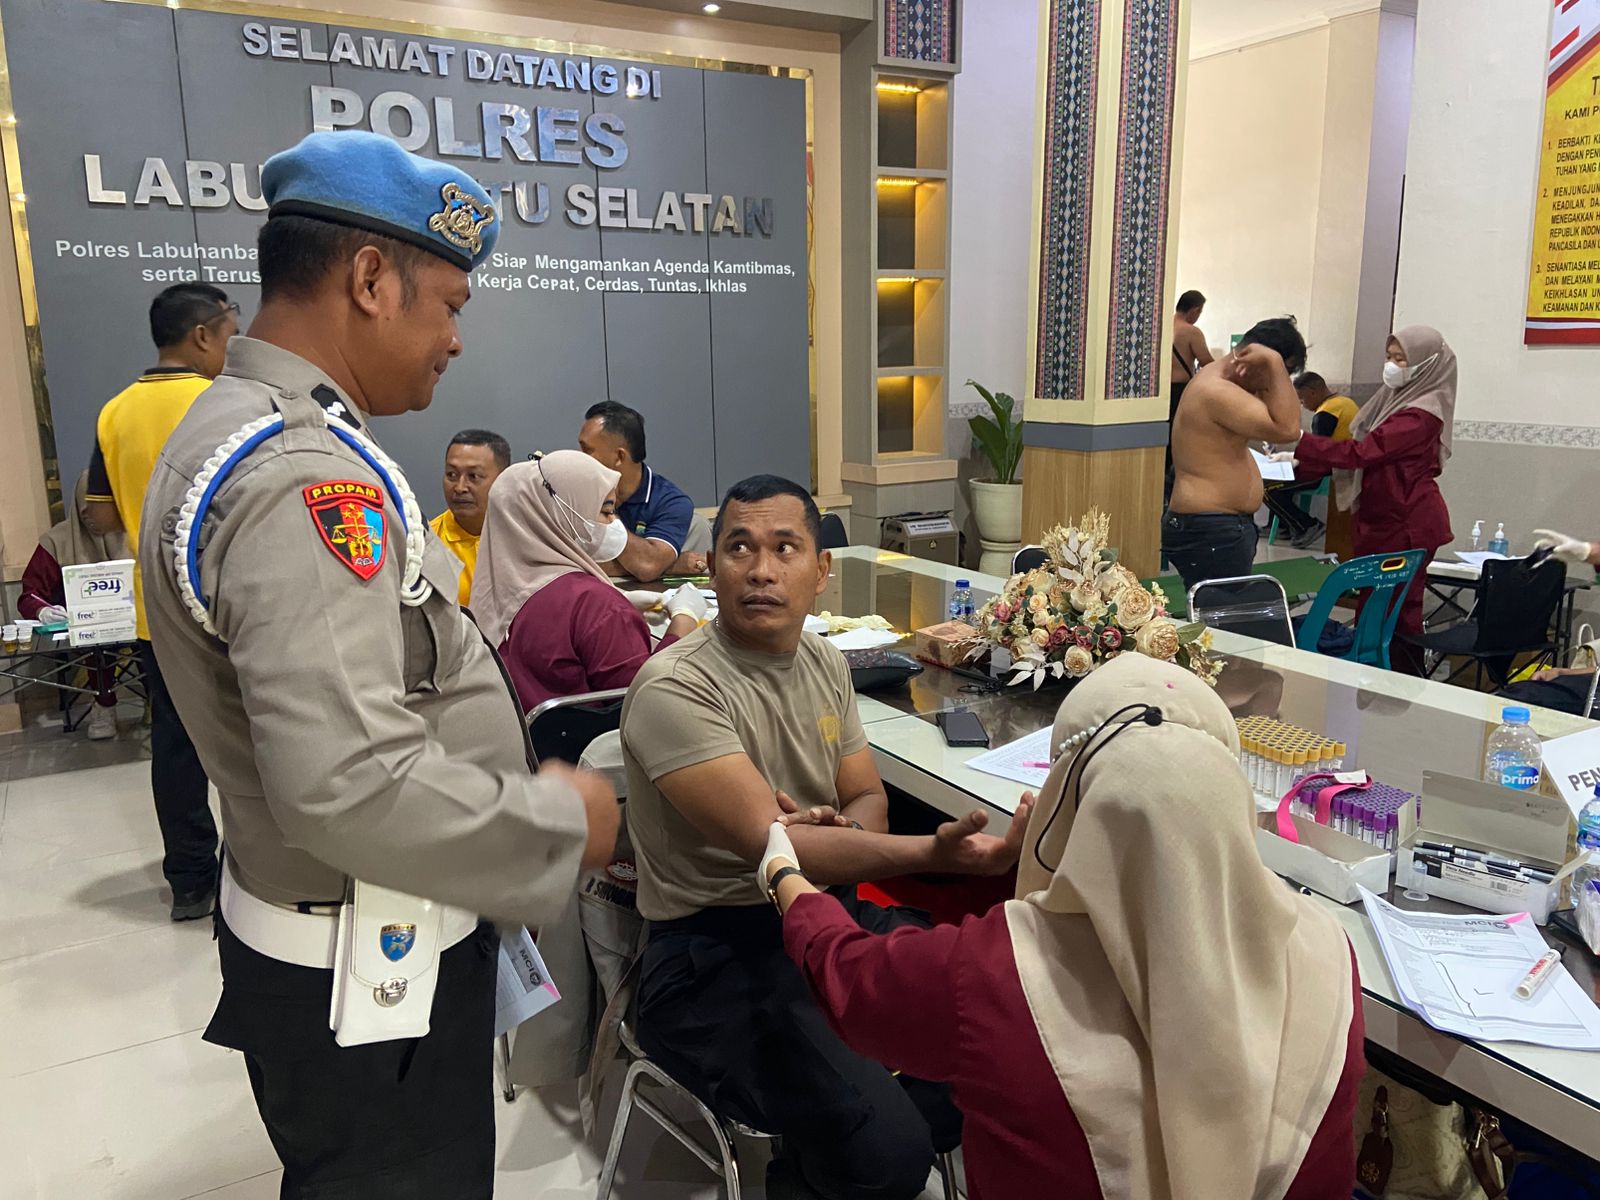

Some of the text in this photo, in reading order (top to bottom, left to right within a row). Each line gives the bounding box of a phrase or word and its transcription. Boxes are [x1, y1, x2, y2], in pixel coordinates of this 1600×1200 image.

[243, 22, 662, 98] SELAMAT DATANG DI
[1564, 106, 1590, 120] KAMI
[311, 85, 629, 168] POLRES
[1557, 135, 1591, 149] BERBAKTI
[1556, 151, 1584, 163] DENGAN
[1555, 162, 1597, 177] TUHAN YANG
[567, 183, 774, 237] SELATAN
[1552, 198, 1586, 211] KEADILAN,
[1551, 211, 1594, 225] MENEGAKKAN
[1549, 226, 1580, 239] REPUBLIK
[1548, 239, 1596, 252] PANCASILA DAN
[55, 240, 130, 258] Polres
[492, 252, 528, 269] Siap
[535, 254, 650, 274] Mengamankan
[653, 258, 709, 275] Agenda
[714, 260, 795, 277] Kamtibmas,
[1546, 261, 1587, 272] SENANTIASA
[142, 266, 747, 294] serta Terus Kerja Cepat, Cerdas, Tuntas, Ikhlas
[1545, 274, 1559, 286] DAN
[1561, 273, 1594, 285] MELAYANI
[1544, 288, 1588, 299] KEIKHLASAN
[1542, 302, 1579, 313] KEAMANAN
[1579, 301, 1594, 312] DAN
[312, 484, 377, 499] PROPAM
